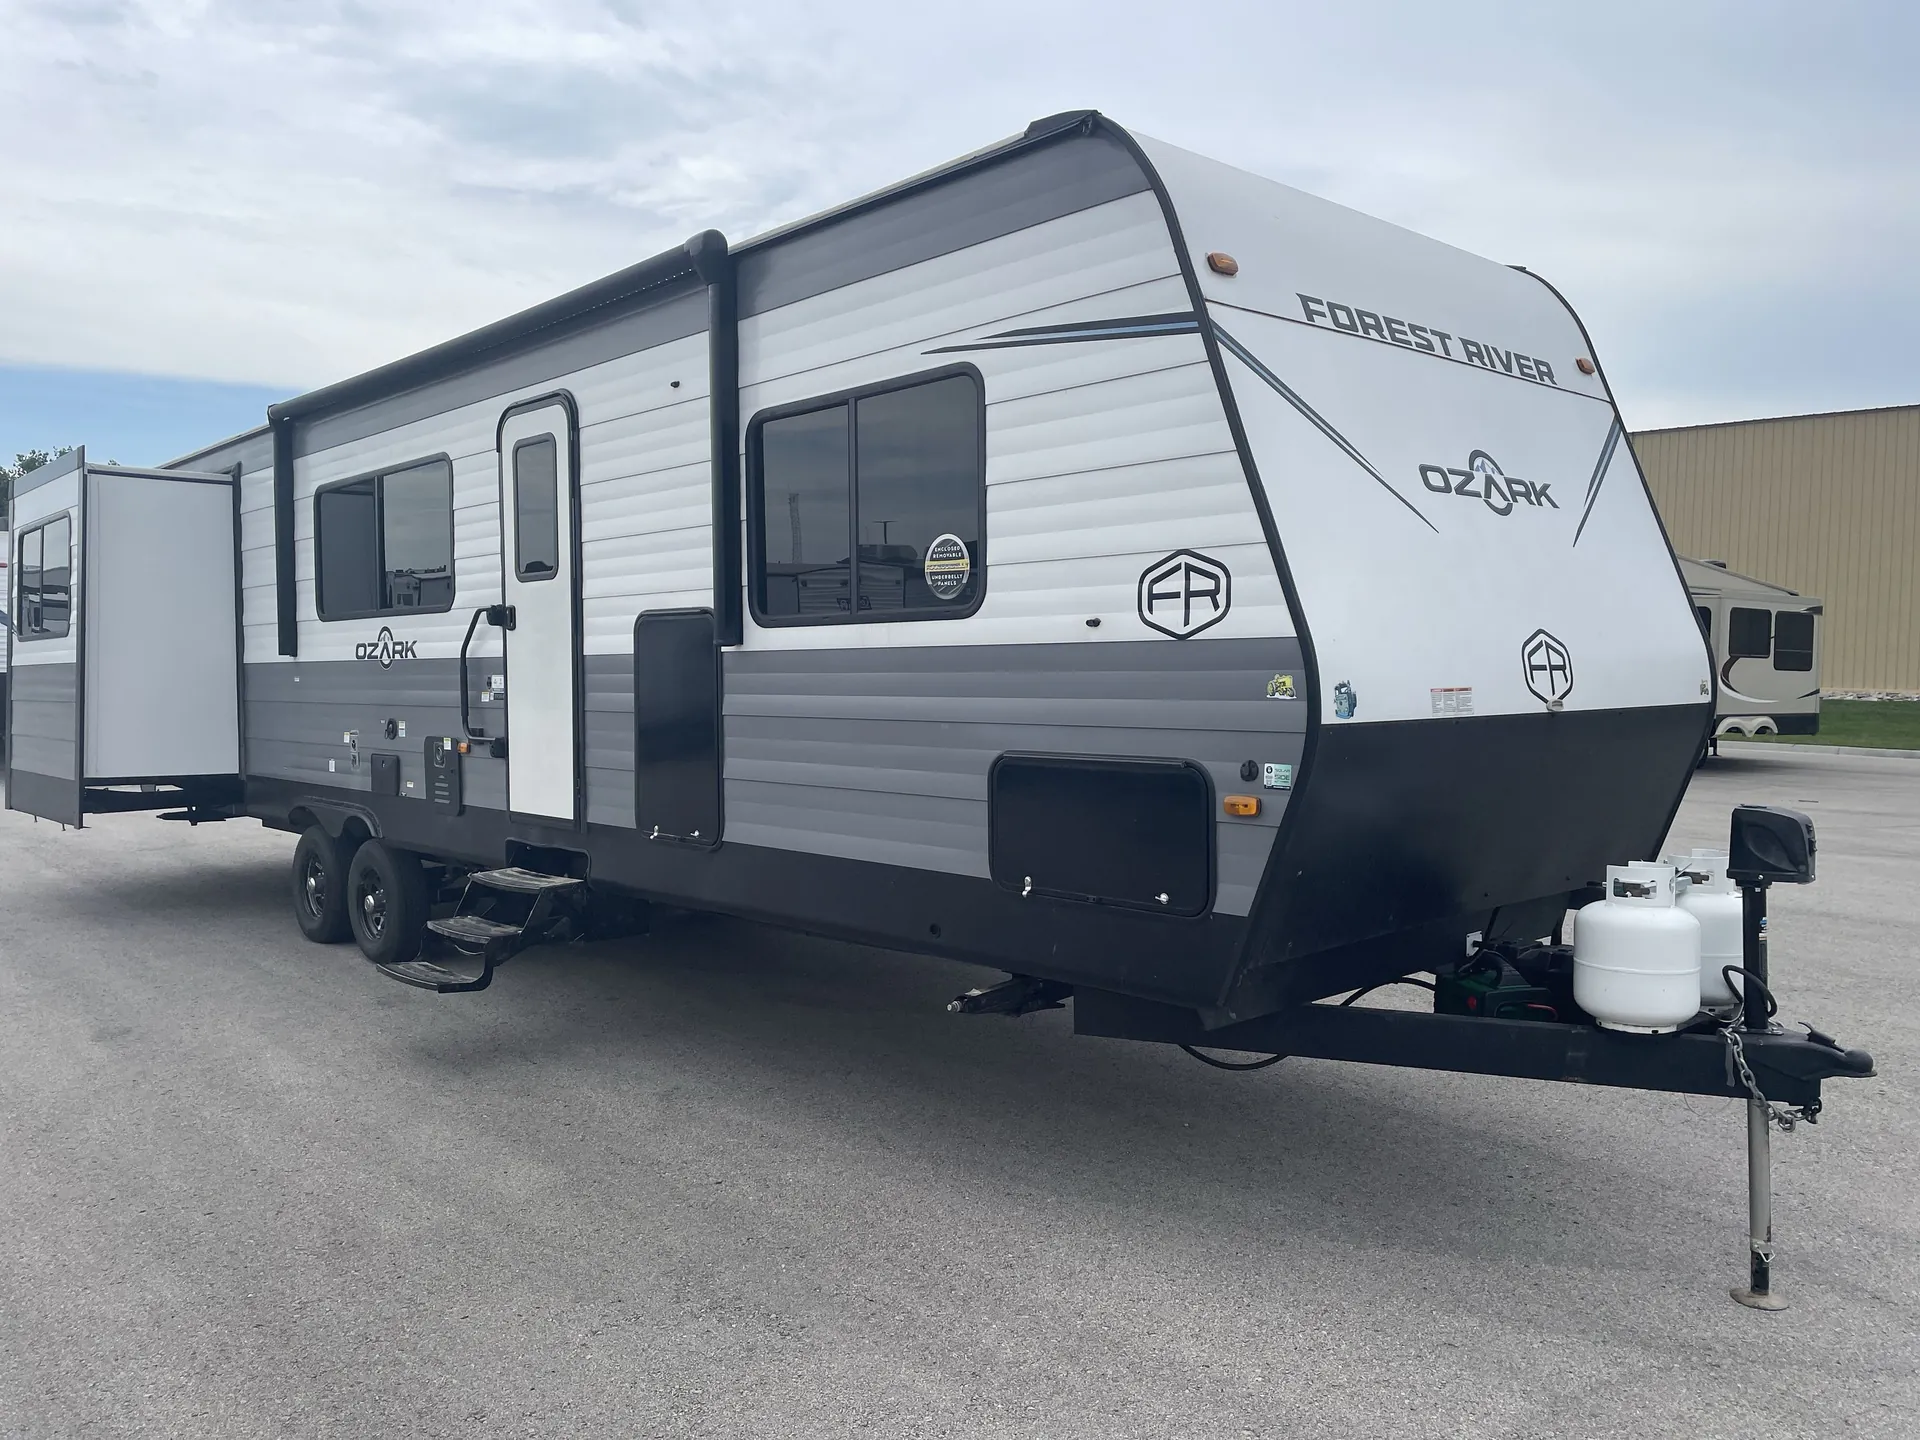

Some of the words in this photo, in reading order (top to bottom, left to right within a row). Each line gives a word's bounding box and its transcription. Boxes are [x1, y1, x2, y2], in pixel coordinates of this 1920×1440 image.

[1295, 292, 1452, 357] FOREST
[1458, 336, 1558, 385] RIVER
[1418, 461, 1560, 510] OZARK
